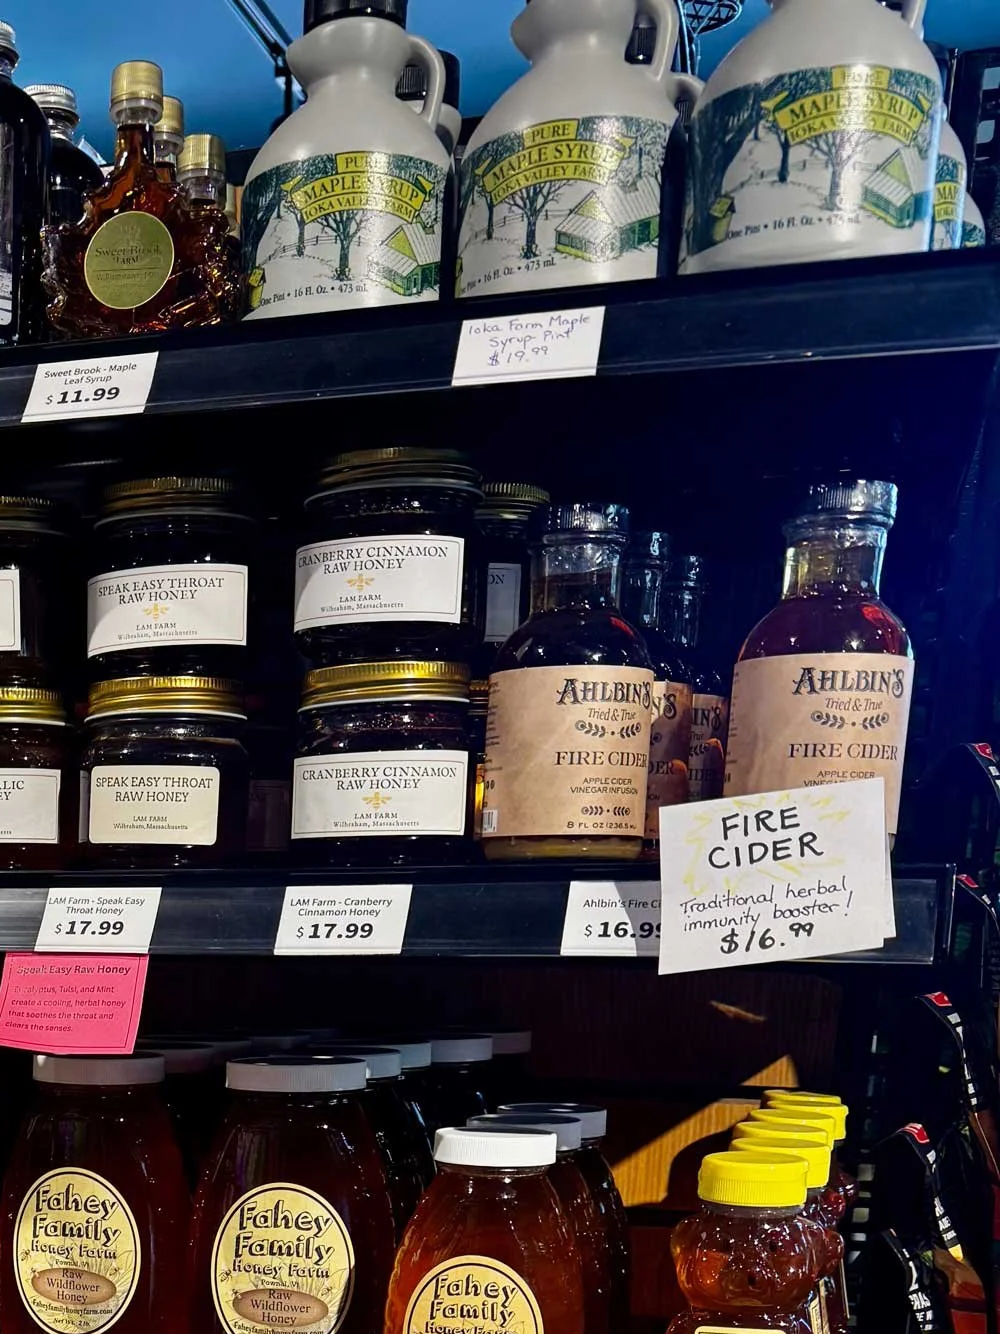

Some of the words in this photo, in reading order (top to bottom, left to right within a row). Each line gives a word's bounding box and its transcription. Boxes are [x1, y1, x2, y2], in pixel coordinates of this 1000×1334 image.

[531, 123, 570, 143] PURE
[492, 150, 548, 184] MAPLE
[553, 143, 615, 163] SYRUP
[294, 289, 303, 298] 16
[338, 283, 353, 293] 473
[509, 318, 543, 331] Farm
[550, 313, 590, 331] Maple
[544, 328, 571, 340] Pint
[44, 369, 72, 379] Sweet
[73, 366, 101, 376] Brook
[109, 362, 137, 374] Maple
[64, 376, 84, 386] Leaf
[86, 374, 112, 386] Syrup
[366, 545, 449, 560] CINNAMON
[98, 582, 130, 598] SPEAK
[132, 579, 165, 592] EASY
[167, 576, 225, 590] THROAT
[118, 592, 151, 605] RAW
[153, 589, 198, 602] HONEY
[556, 678, 651, 710] AHLBIN'S
[792, 666, 905, 698] AHLBIN'S
[554, 751, 605, 766] FIRE
[608, 750, 647, 768] CIDER
[788, 743, 842, 759] FIRE
[847, 743, 898, 760] CIDER
[721, 806, 801, 841] FIRE
[707, 831, 824, 870] CIDER
[49, 897, 66, 905] LAM
[68, 897, 90, 905] Farm
[97, 897, 123, 907] Speak
[125, 897, 145, 907] Easy
[95, 907, 124, 916] Honey
[680, 884, 774, 915] Traditional
[684, 905, 761, 933] immunity
[720, 921, 815, 955] $16.99
[35, 1183, 119, 1221] Fahey
[33, 1214, 122, 1248] Family
[238, 1200, 334, 1235] Fahey
[235, 1233, 336, 1266] Family
[434, 1274, 519, 1308] Fahey
[430, 1299, 516, 1327] Family
